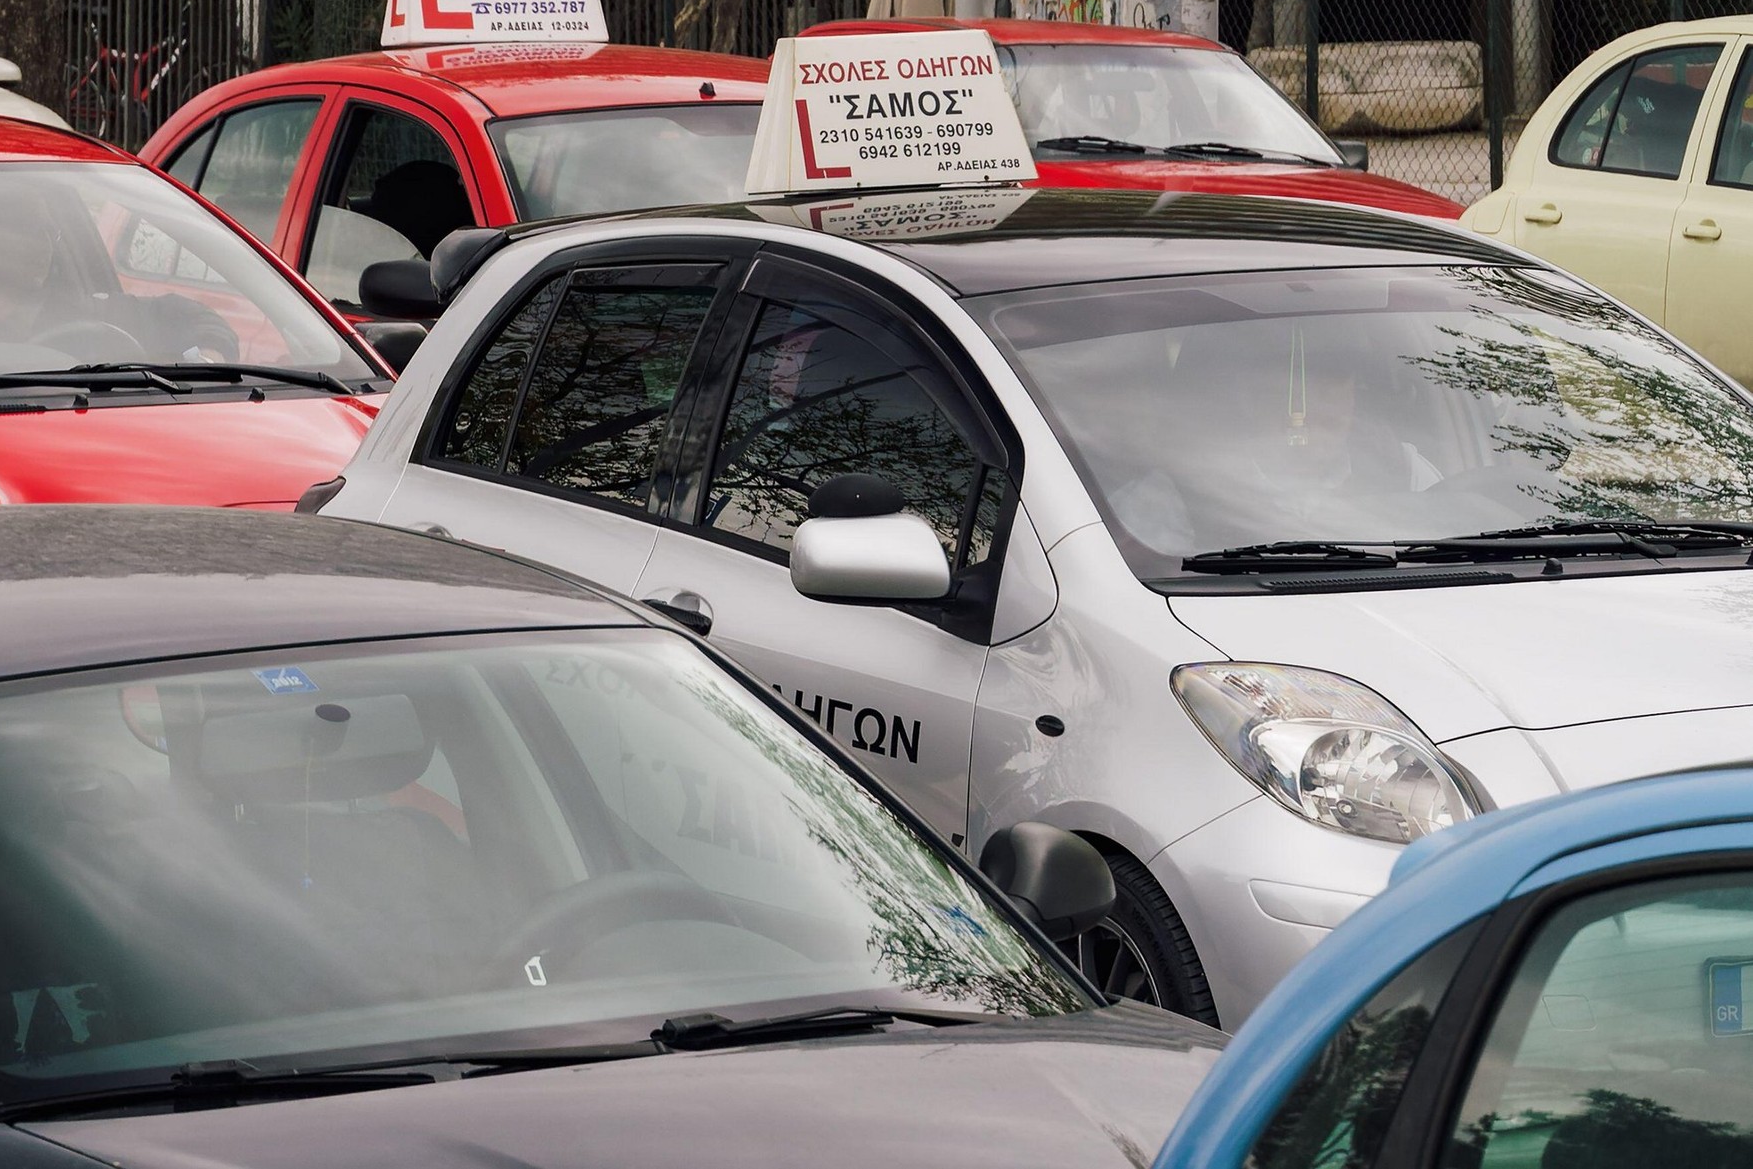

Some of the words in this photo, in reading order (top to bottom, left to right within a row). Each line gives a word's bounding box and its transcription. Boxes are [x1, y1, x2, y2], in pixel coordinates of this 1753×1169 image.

[495, 2, 527, 15] 6977
[532, 1, 586, 14] 352.787
[490, 21, 544, 32] ΑΡ.ΑΔΕΙΑΣ
[551, 21, 590, 31] 12-0324
[799, 60, 889, 85] ΣΧΟΛΕΣ
[897, 55, 993, 79] ΟΔΗΓΩΝ
[829, 89, 974, 120] "ΣΑΜΟΣ"
[795, 99, 852, 179] L
[819, 128, 860, 144] 2310
[865, 125, 923, 141] 541639
[936, 122, 994, 138] 690799
[858, 144, 898, 160] 6942
[903, 142, 961, 157] 612199
[937, 159, 998, 172] ΑΡ.ΑΔΕΙΑΣ
[1001, 158, 1020, 169] 438
[772, 684, 921, 764] ΗΓΩΝ
[1717, 1005, 1739, 1022] GR
